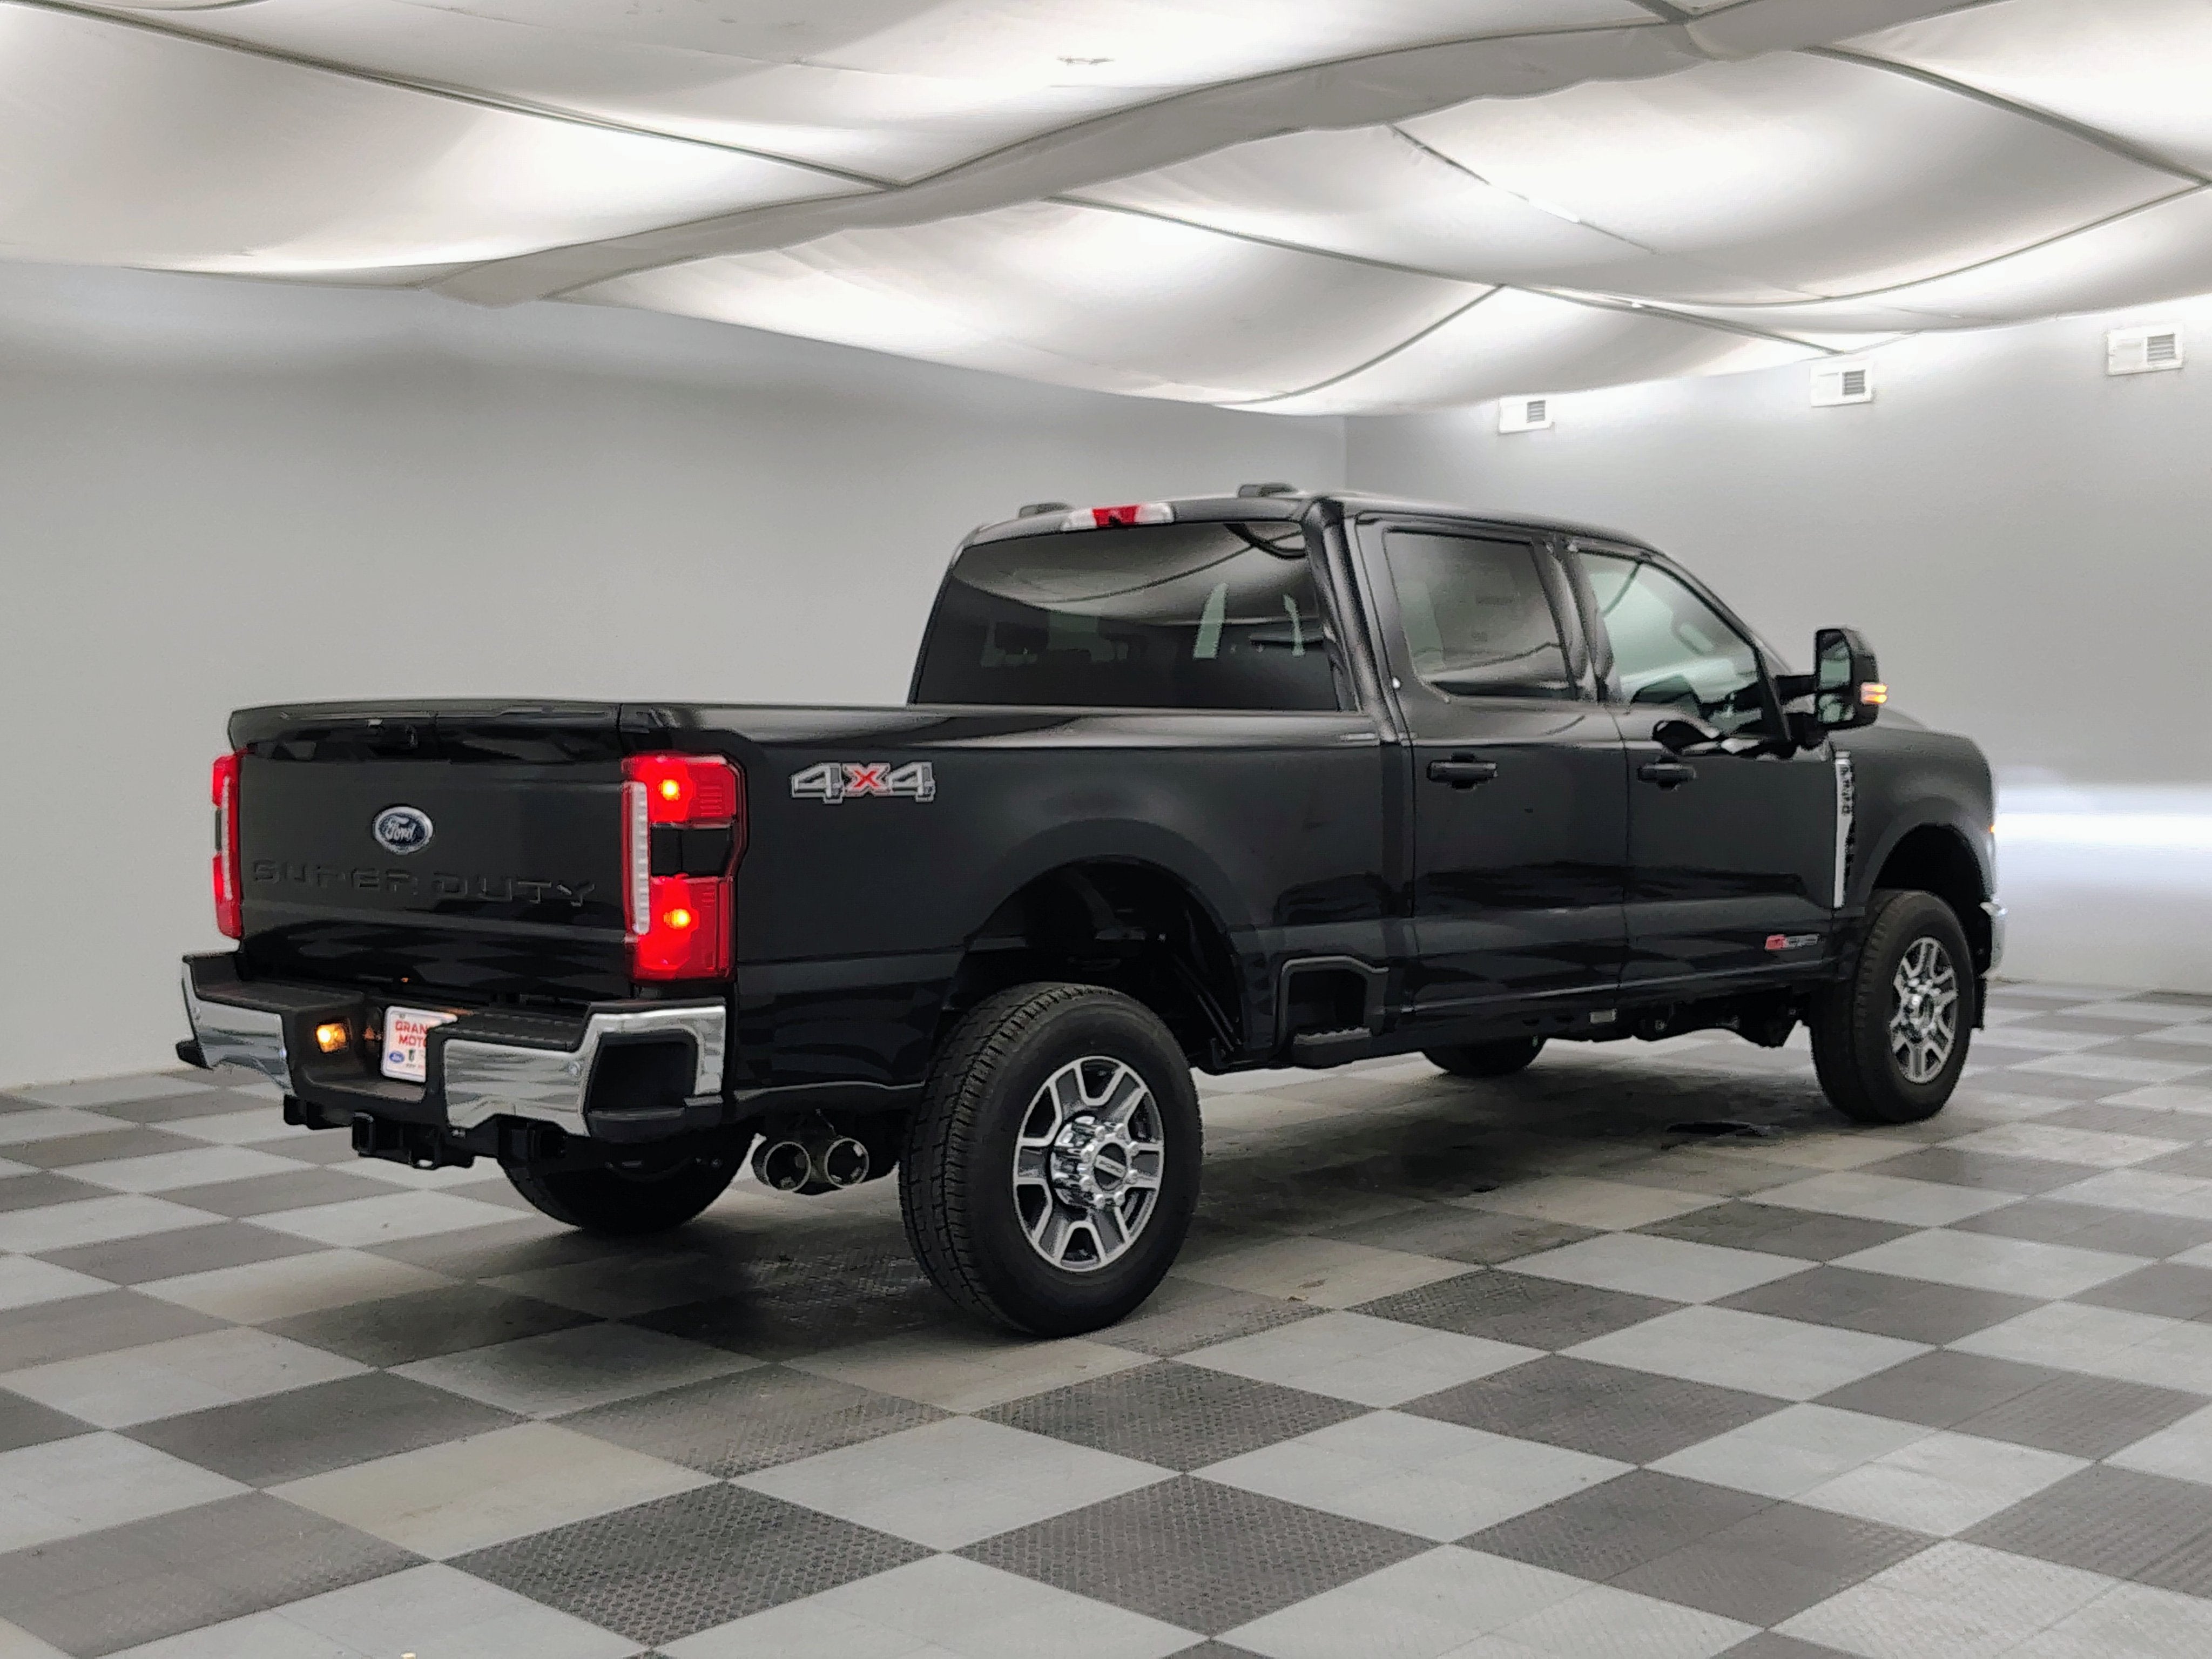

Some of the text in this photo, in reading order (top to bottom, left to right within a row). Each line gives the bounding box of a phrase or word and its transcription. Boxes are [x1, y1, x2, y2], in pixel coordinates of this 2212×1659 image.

[382, 814, 418, 842] Ford
[253, 859, 596, 907] SUPER DUTY
